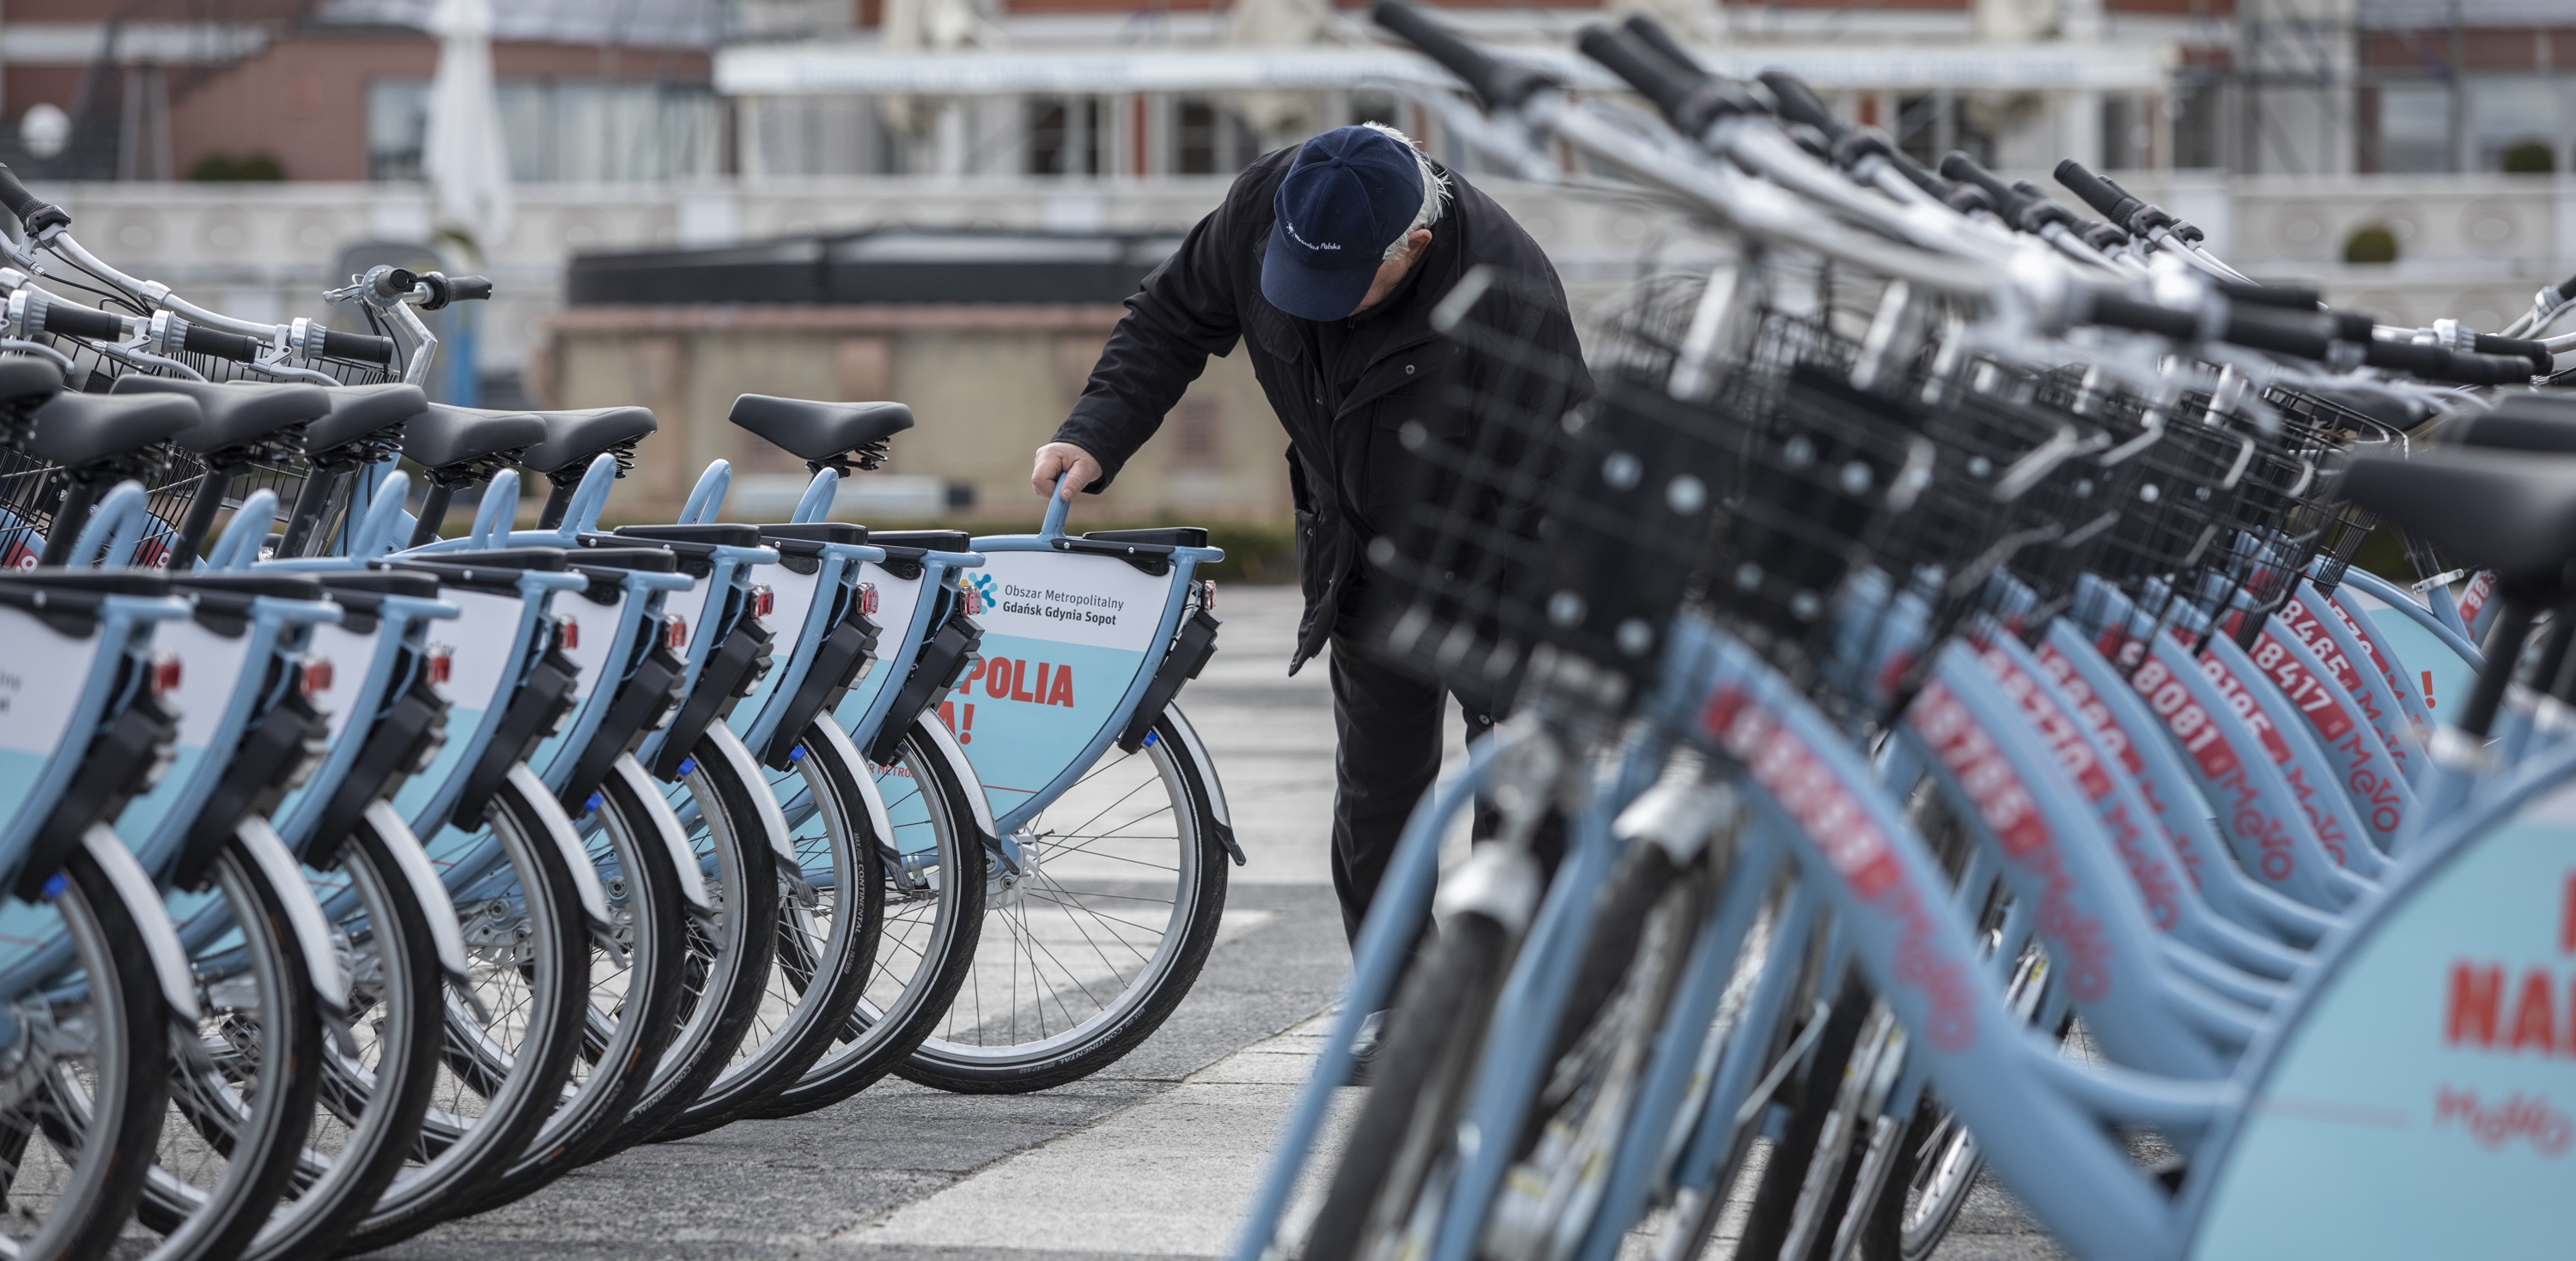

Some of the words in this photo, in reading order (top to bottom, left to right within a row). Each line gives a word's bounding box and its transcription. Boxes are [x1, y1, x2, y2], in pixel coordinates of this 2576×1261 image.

[1003, 602, 1042, 615] Gdańsk
[1045, 607, 1082, 621] Gdynia
[1084, 611, 1116, 626] Sopot
[1005, 585, 1042, 599] Obszar
[1045, 590, 1124, 611] Metropolitalny
[2275, 586, 2350, 677] 8465
[948, 656, 1073, 707] POLIA
[2249, 630, 2334, 712] 8417
[878, 764, 914, 779] METRO
[855, 864, 866, 933] CONTINENTAL
[1059, 1028, 1122, 1064] CONTINENTAL
[636, 1065, 692, 1114] CONTINENTAL
